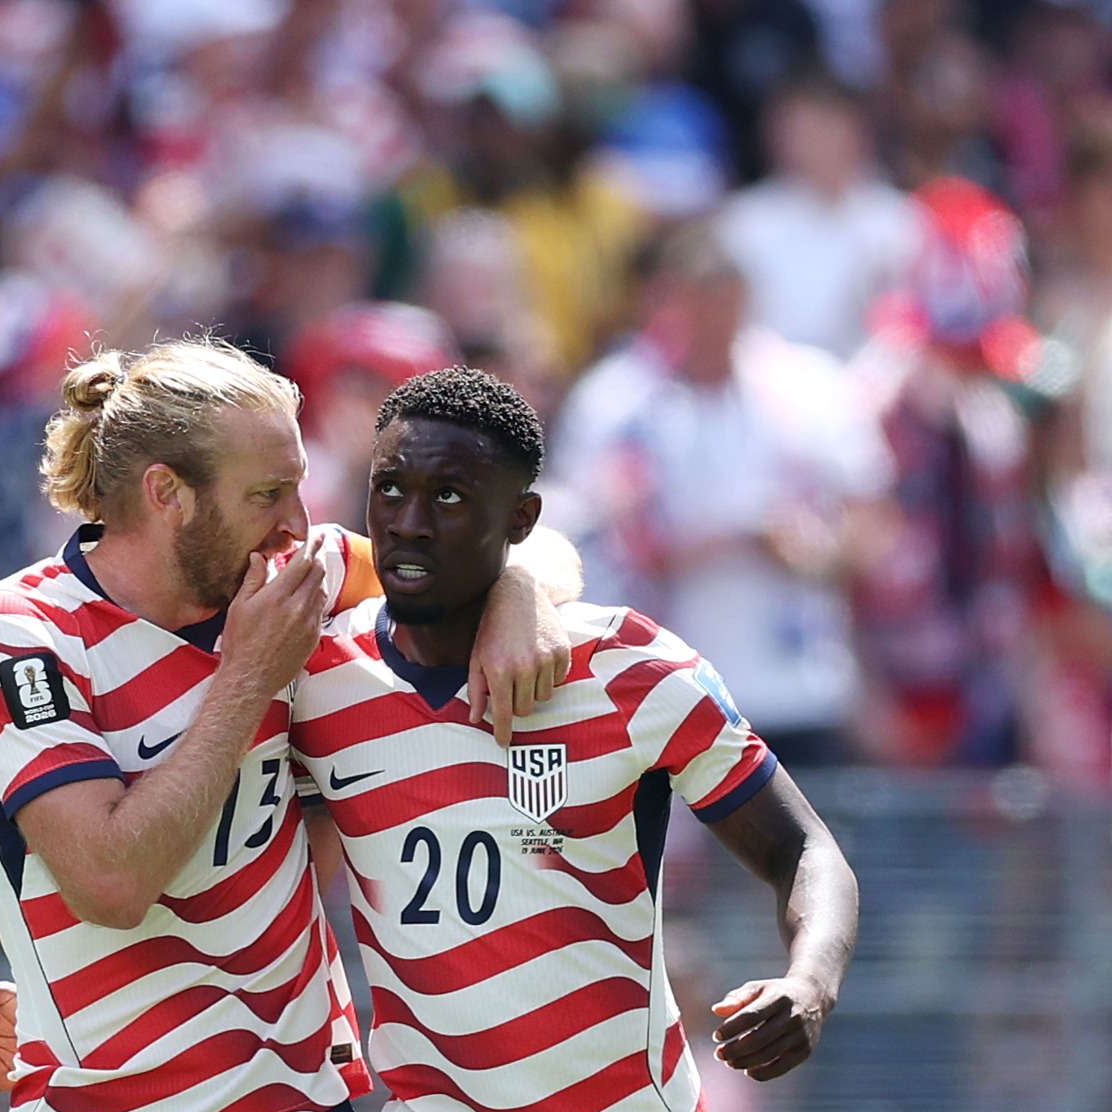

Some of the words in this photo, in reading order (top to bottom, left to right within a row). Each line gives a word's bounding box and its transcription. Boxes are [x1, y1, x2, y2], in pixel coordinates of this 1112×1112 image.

[26, 709, 57, 723] 2026
[511, 748, 562, 777] USA
[213, 758, 281, 867] 13
[400, 826, 501, 926] 20
